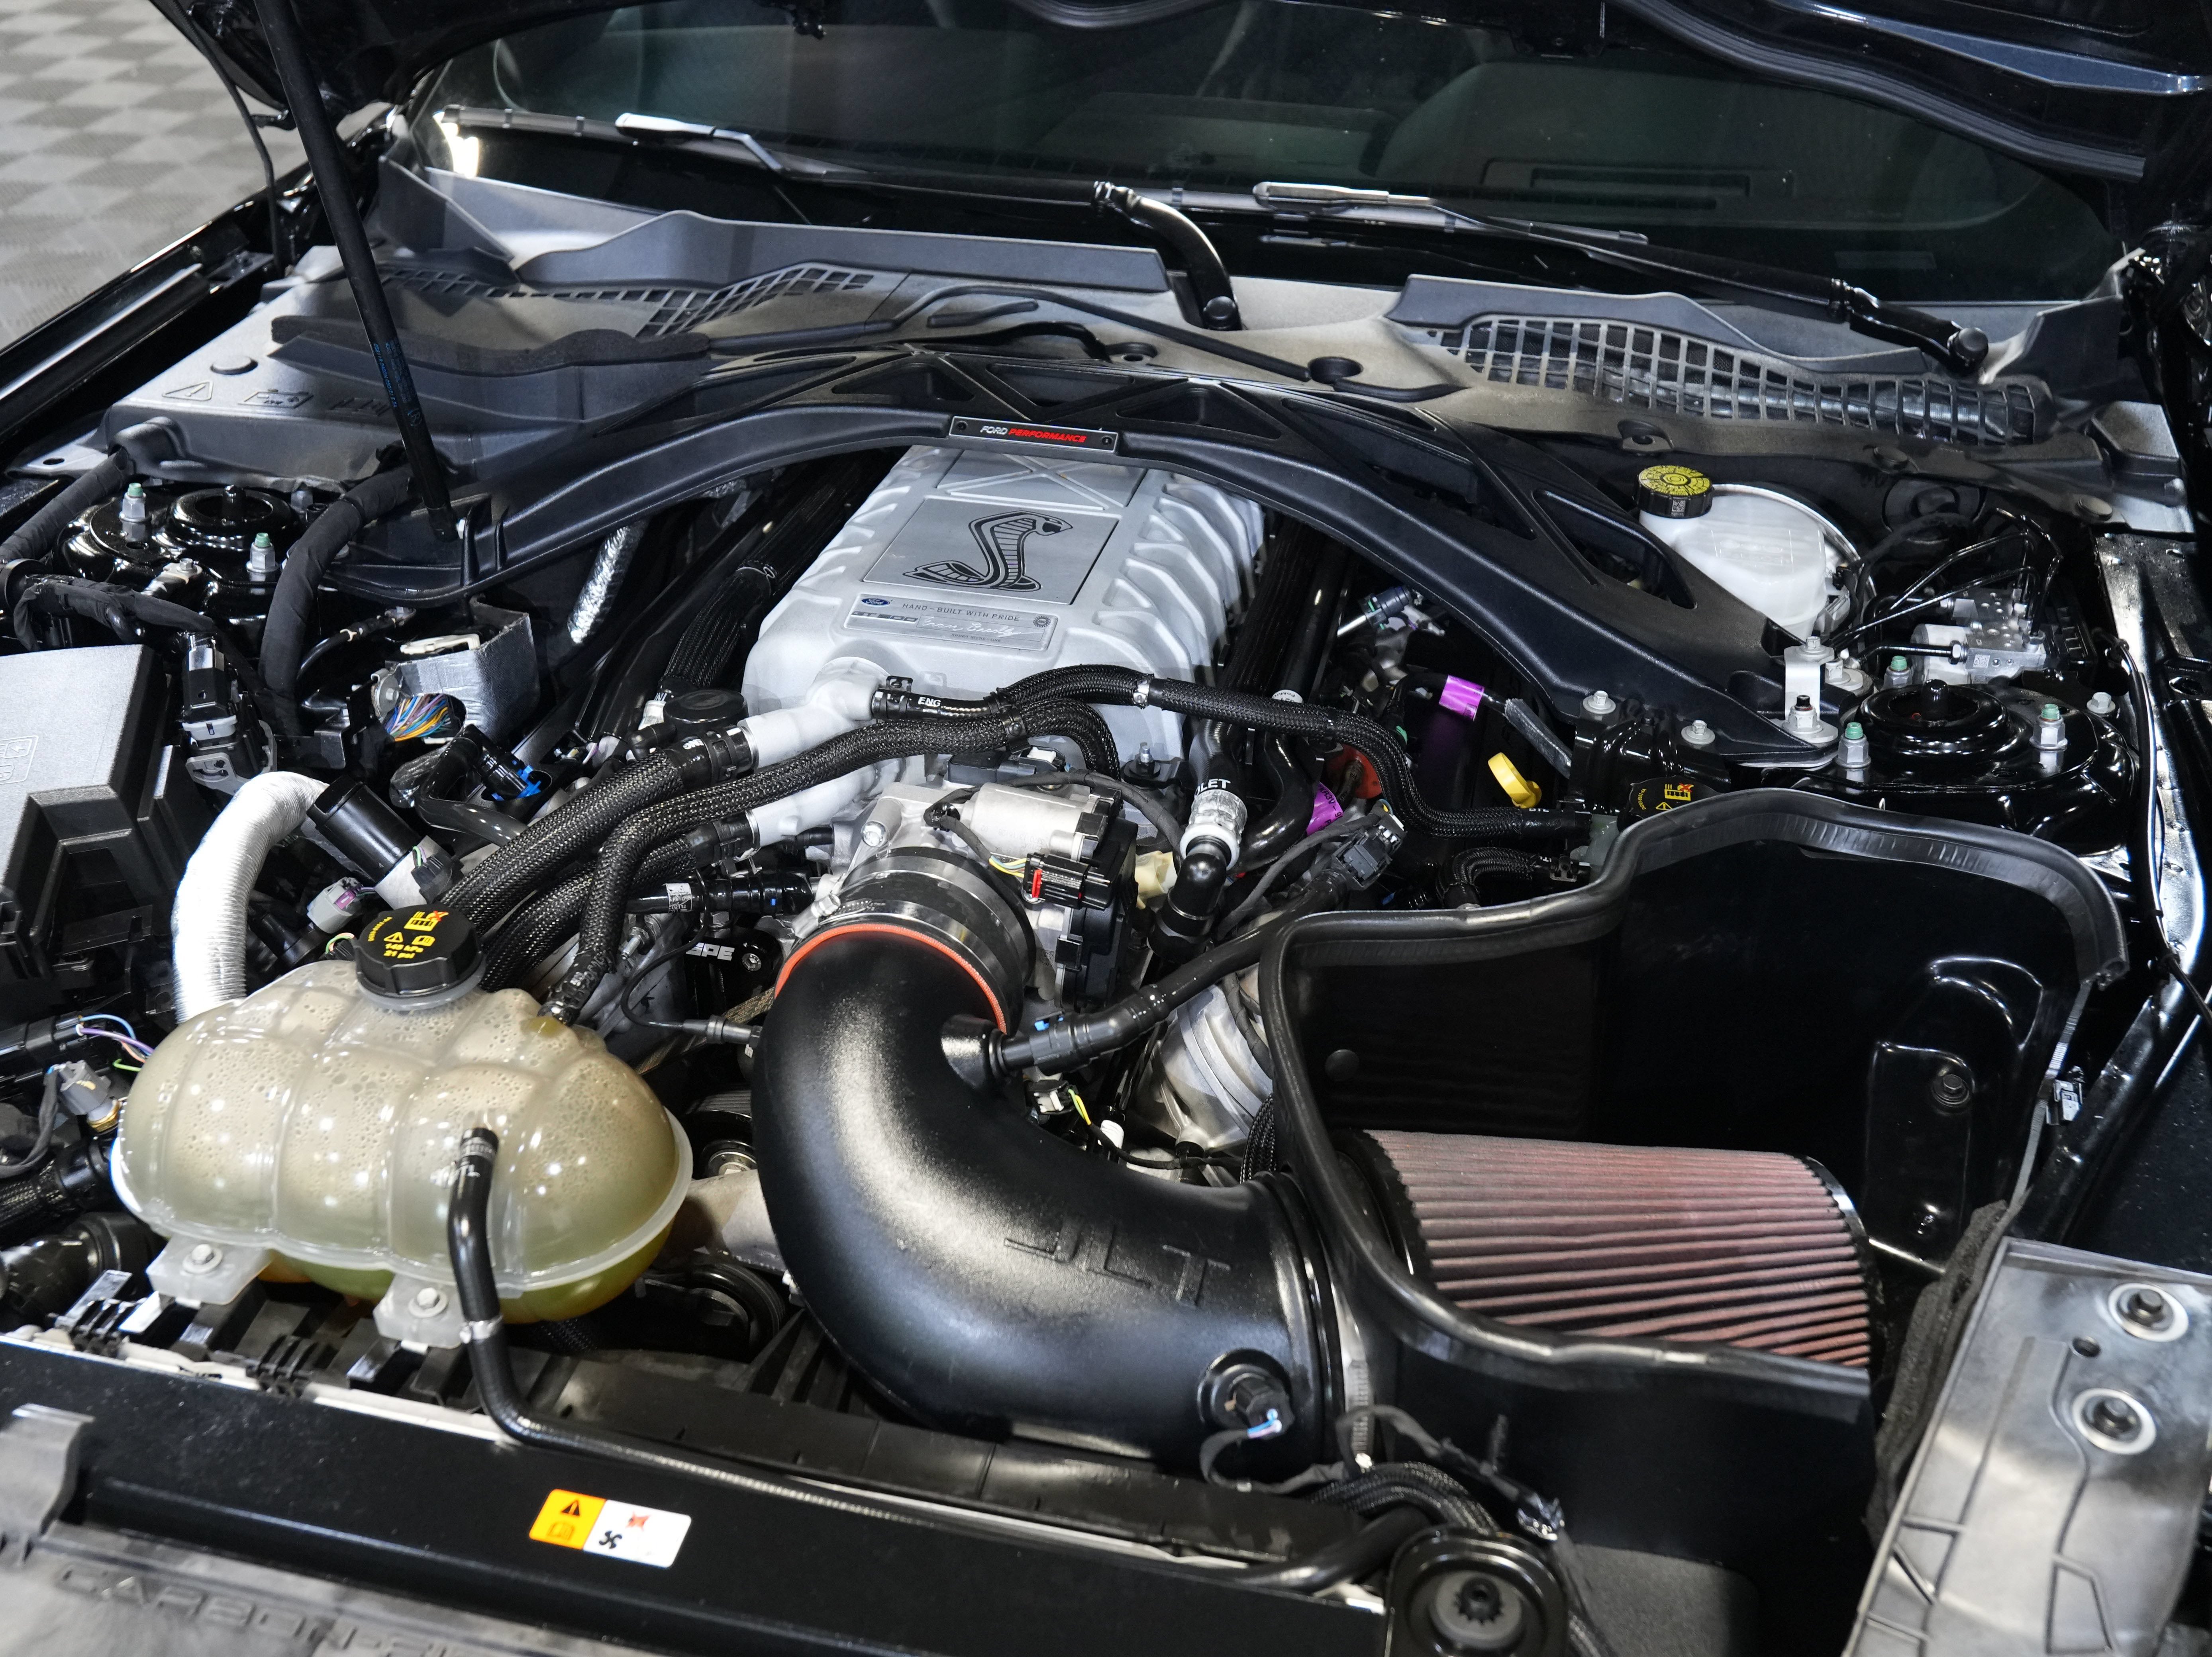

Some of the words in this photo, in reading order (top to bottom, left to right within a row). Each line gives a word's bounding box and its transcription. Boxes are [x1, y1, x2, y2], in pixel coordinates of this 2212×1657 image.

[980, 425, 1008, 435] FORD
[1008, 428, 1087, 443] PERFORMANCE
[937, 607, 961, 615] BUILT
[992, 613, 1020, 622] PRIDE
[918, 697, 941, 707] ENG
[686, 942, 735, 961] SPE
